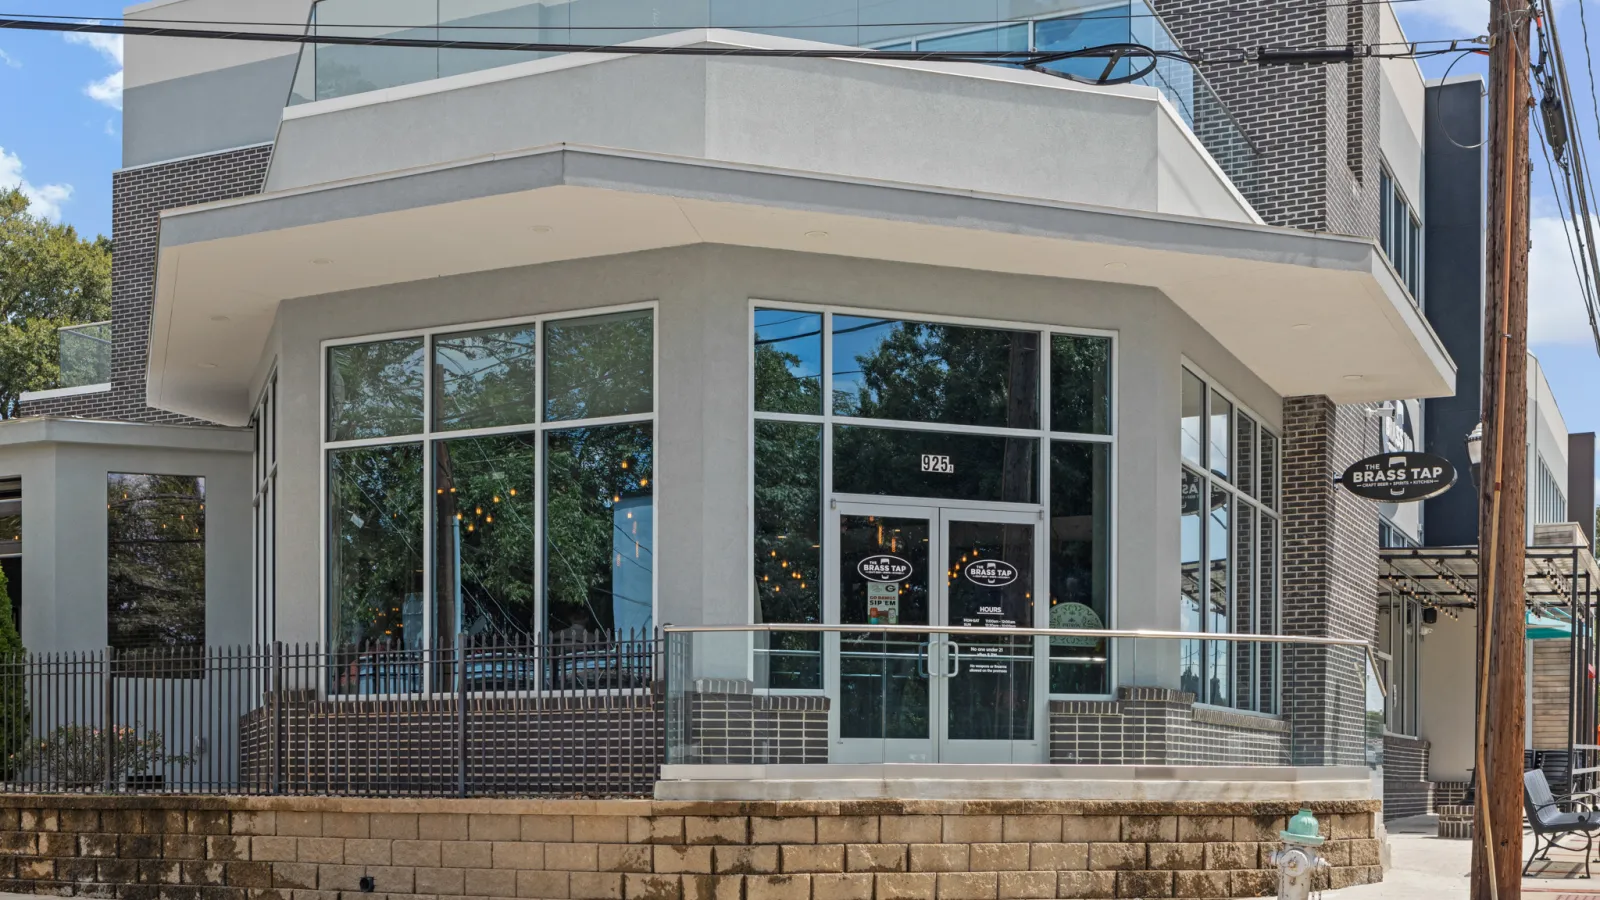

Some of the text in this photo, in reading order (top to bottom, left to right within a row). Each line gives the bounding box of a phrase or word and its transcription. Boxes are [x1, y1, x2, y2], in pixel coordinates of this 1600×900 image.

[1353, 467, 1443, 483] BRASS TAP
[863, 564, 890, 572] BRASS
[891, 565, 907, 573] TAP
